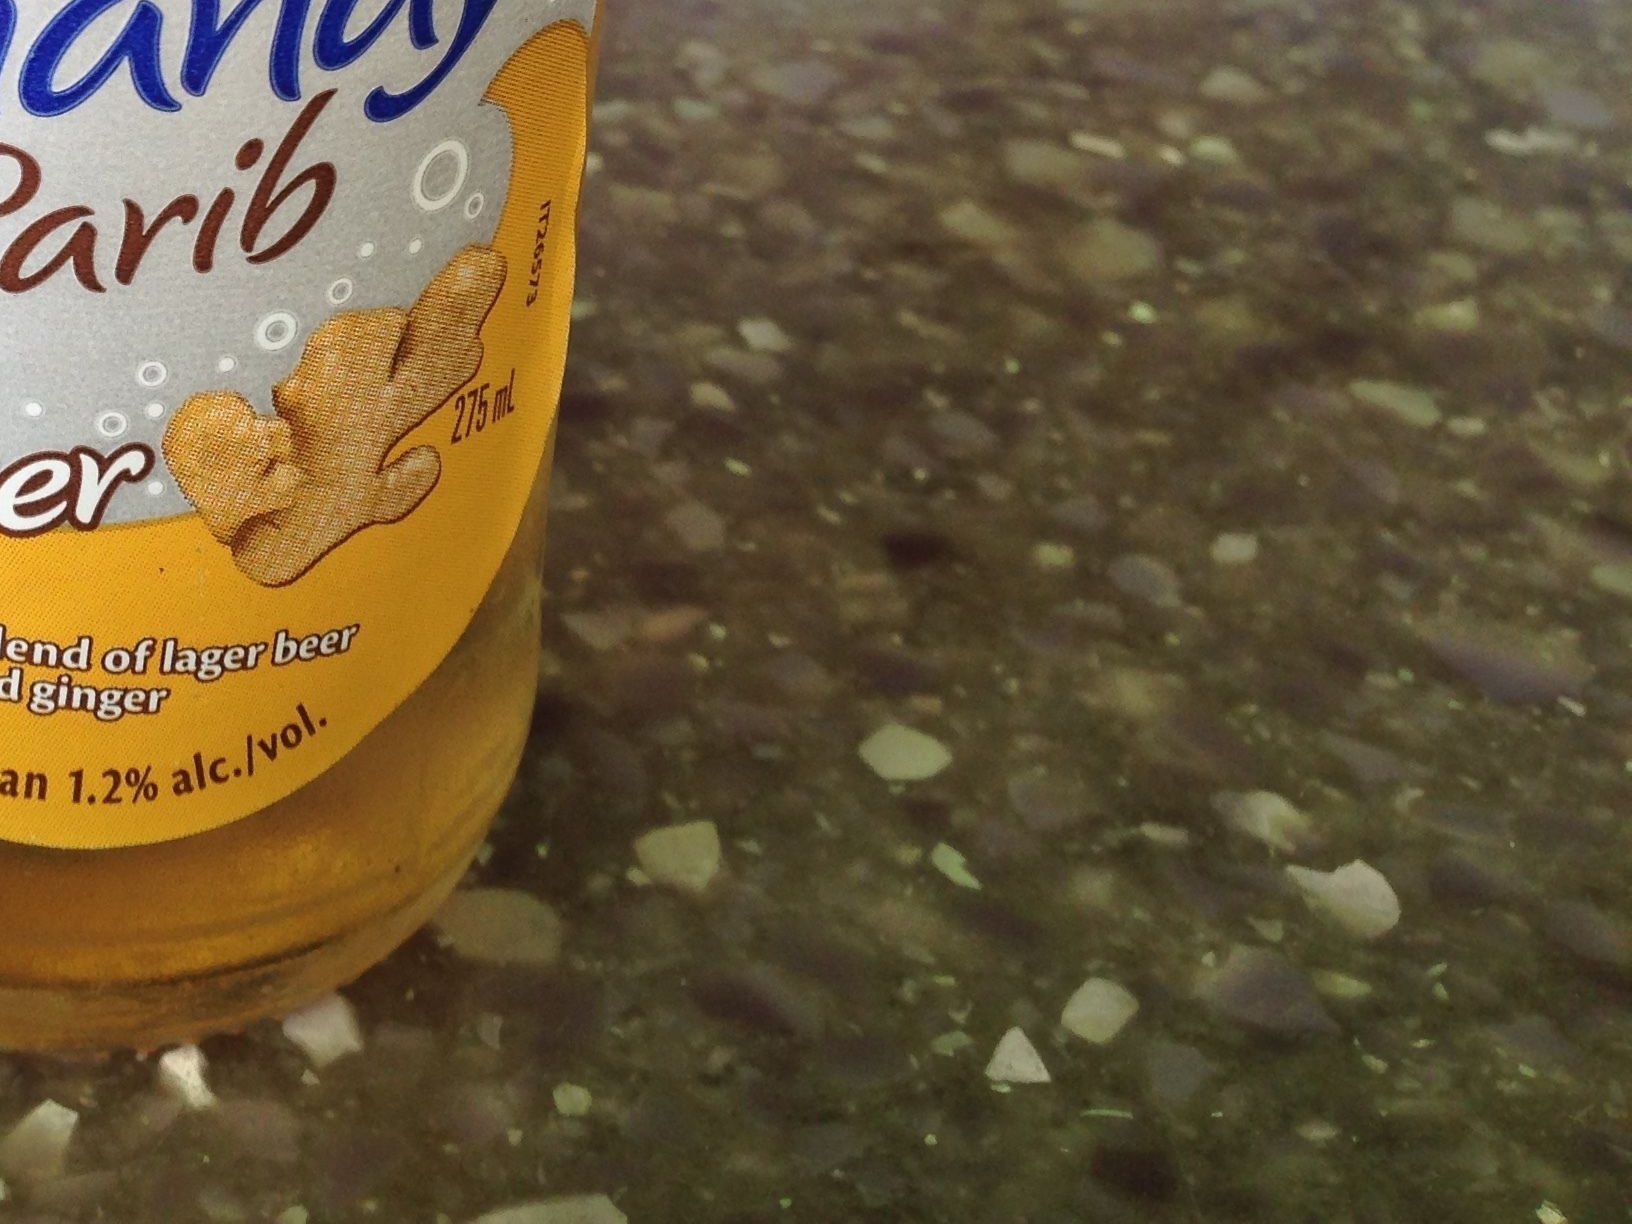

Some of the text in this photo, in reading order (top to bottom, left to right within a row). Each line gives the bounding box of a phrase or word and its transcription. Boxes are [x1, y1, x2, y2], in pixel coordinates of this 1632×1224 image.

[526, 200, 551, 307] IT26573
[451, 383, 490, 444] 275
[102, 637, 155, 674] of
[159, 637, 268, 683] lager
[271, 623, 360, 666] beer
[27, 674, 171, 722] ginger
[69, 765, 159, 805] 1.2%
[171, 702, 328, 797] alc./vol.
